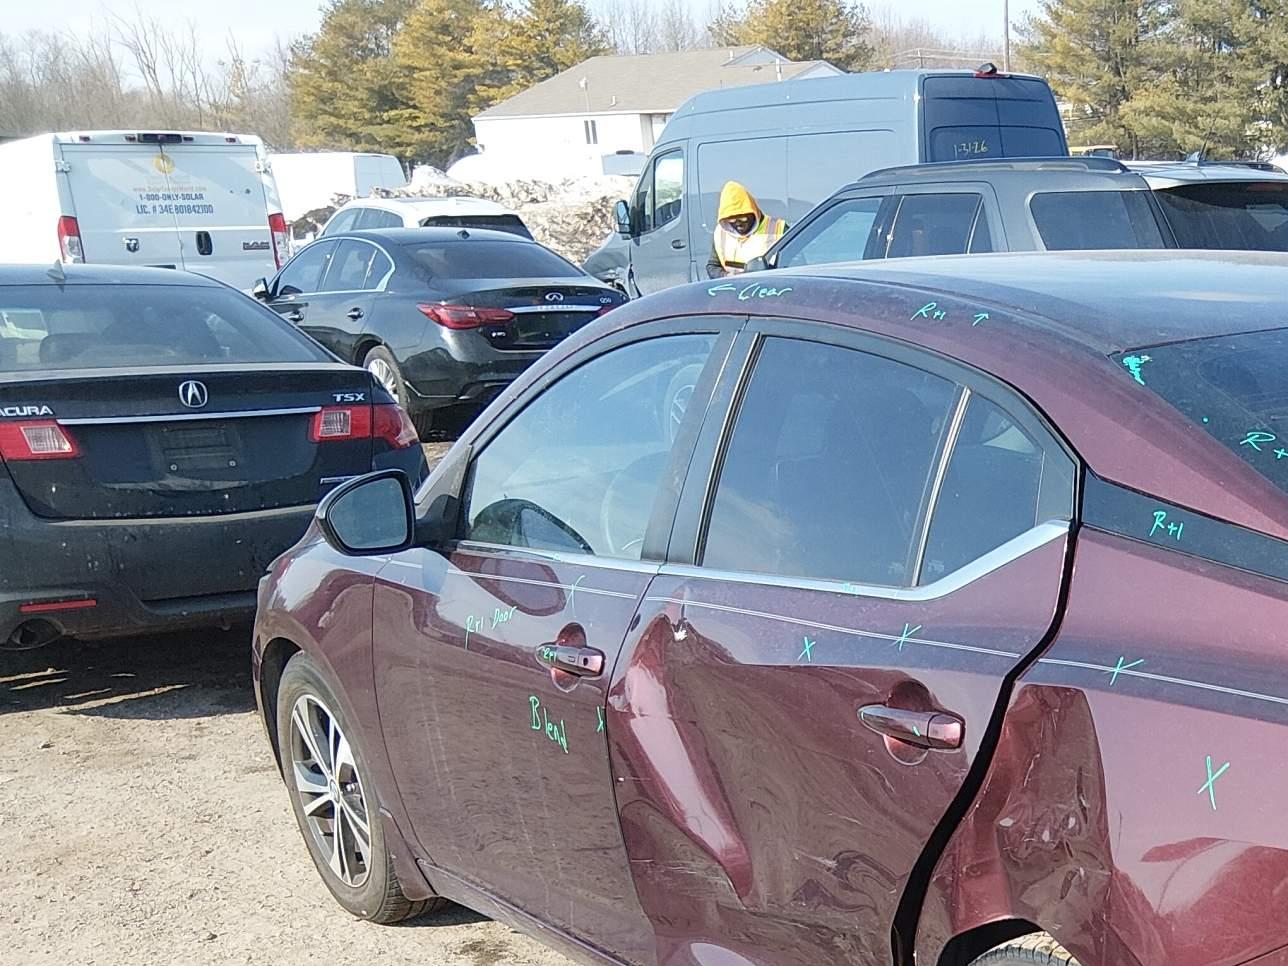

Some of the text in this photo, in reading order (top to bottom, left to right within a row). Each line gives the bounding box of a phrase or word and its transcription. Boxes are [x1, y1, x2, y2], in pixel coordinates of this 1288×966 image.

[136, 204, 151, 214] LIC.
[333, 392, 366, 402] TSX
[529, 695, 570, 754] Blend
